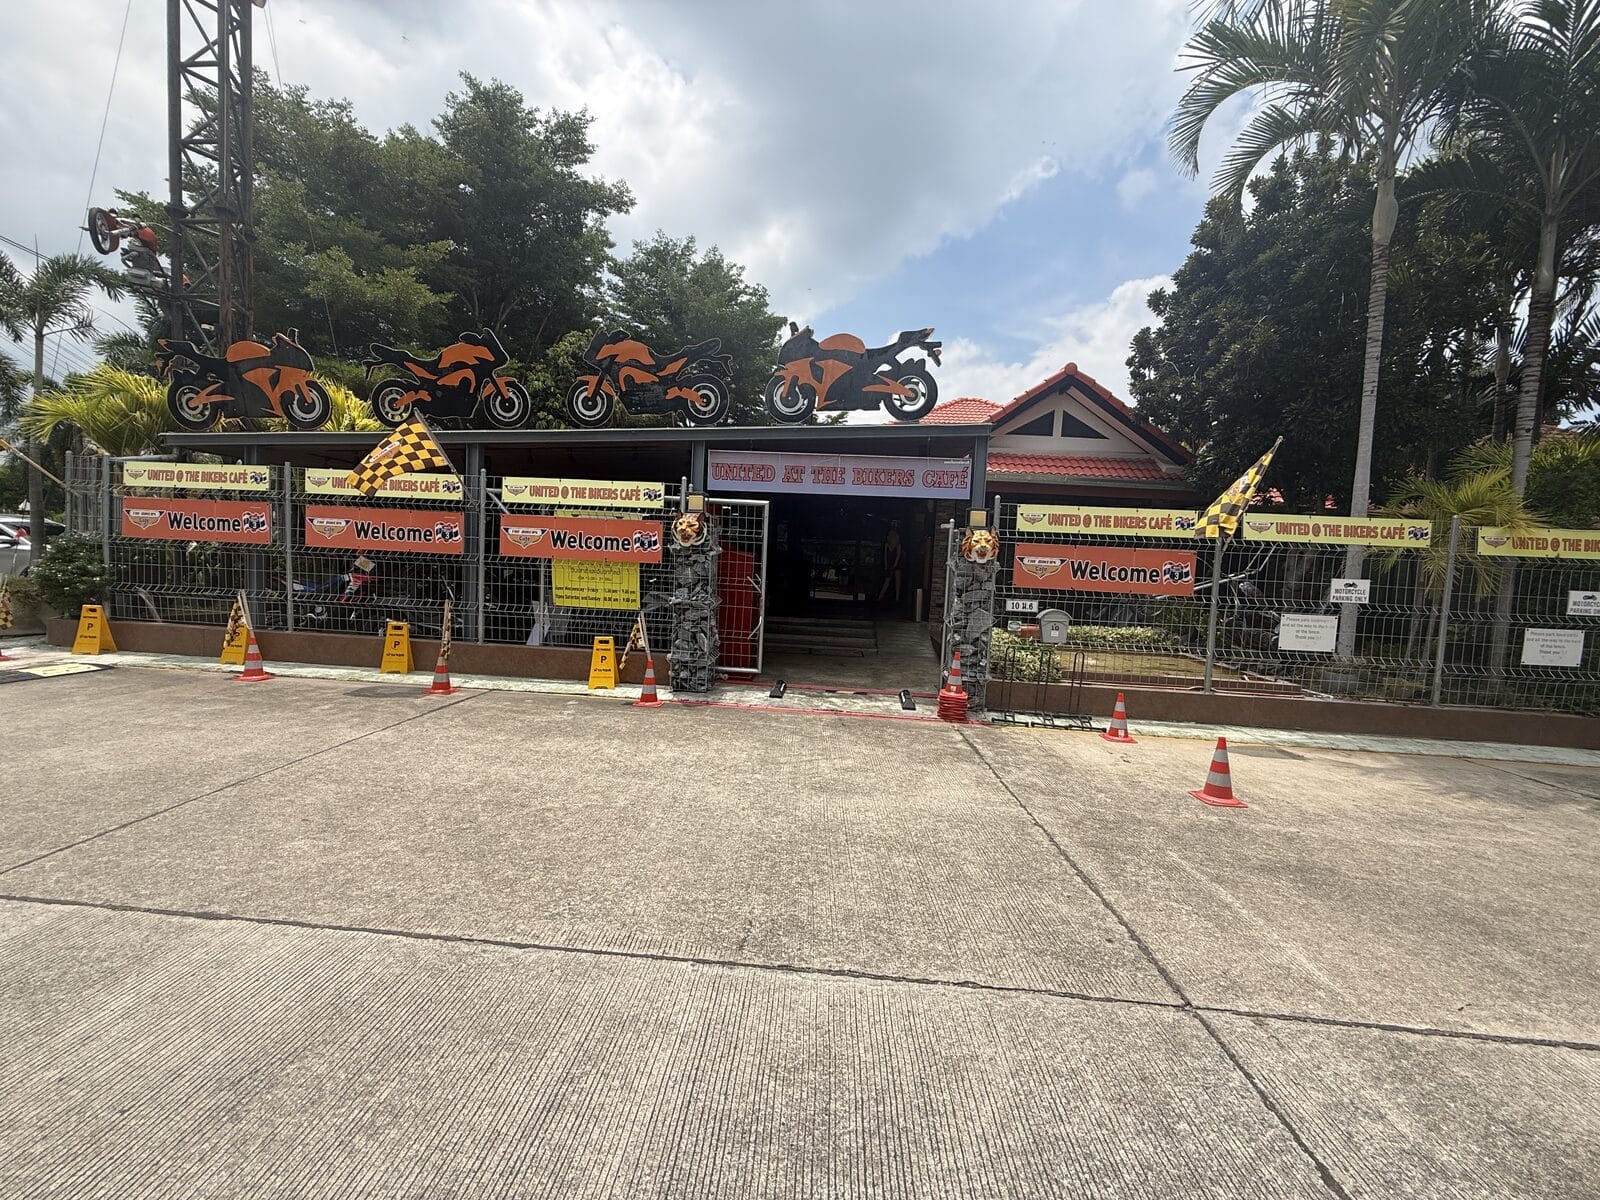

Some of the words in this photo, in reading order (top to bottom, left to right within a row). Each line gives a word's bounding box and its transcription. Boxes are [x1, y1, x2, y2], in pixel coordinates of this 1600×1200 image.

[147, 469, 175, 481] UNITED
[176, 470, 184, 482] @
[185, 470, 200, 482] THE
[200, 471, 228, 483] BIKERS
[229, 469, 248, 484] CAFÉ
[711, 463, 776, 482] UNITED
[782, 465, 805, 484] AT
[810, 466, 845, 485] THE
[852, 468, 915, 488] BIKERS
[922, 467, 969, 489] CAFÉ
[389, 479, 419, 492] BIKERS
[420, 477, 440, 493] CAFÉ
[529, 485, 559, 497] UNITED
[560, 486, 569, 499] @
[570, 487, 587, 499] THE
[587, 487, 619, 500] BIKERS
[619, 485, 641, 500] CAFÉ
[167, 511, 241, 532] Welcome
[1047, 513, 1080, 526] UNITED
[1082, 514, 1092, 528] @
[1093, 515, 1112, 528] THE
[1113, 515, 1147, 529] BIKERS
[1148, 514, 1172, 530] CAFÉ
[354, 521, 433, 542] Welcome
[1275, 521, 1310, 536] UNITED
[1311, 523, 1321, 537] @
[1322, 524, 1341, 537] THE
[1343, 524, 1379, 539] BIKERS
[1380, 523, 1405, 540] CAFÉ
[551, 530, 631, 552] Welcome
[1511, 536, 1548, 551] UNITED
[1550, 537, 1560, 552] @
[1562, 538, 1582, 552] THE
[1070, 560, 1160, 584] Welcome
[1011, 602, 1020, 610] 10
[87, 622, 94, 631] P
[393, 640, 400, 649] P
[600, 655, 608, 664] P
